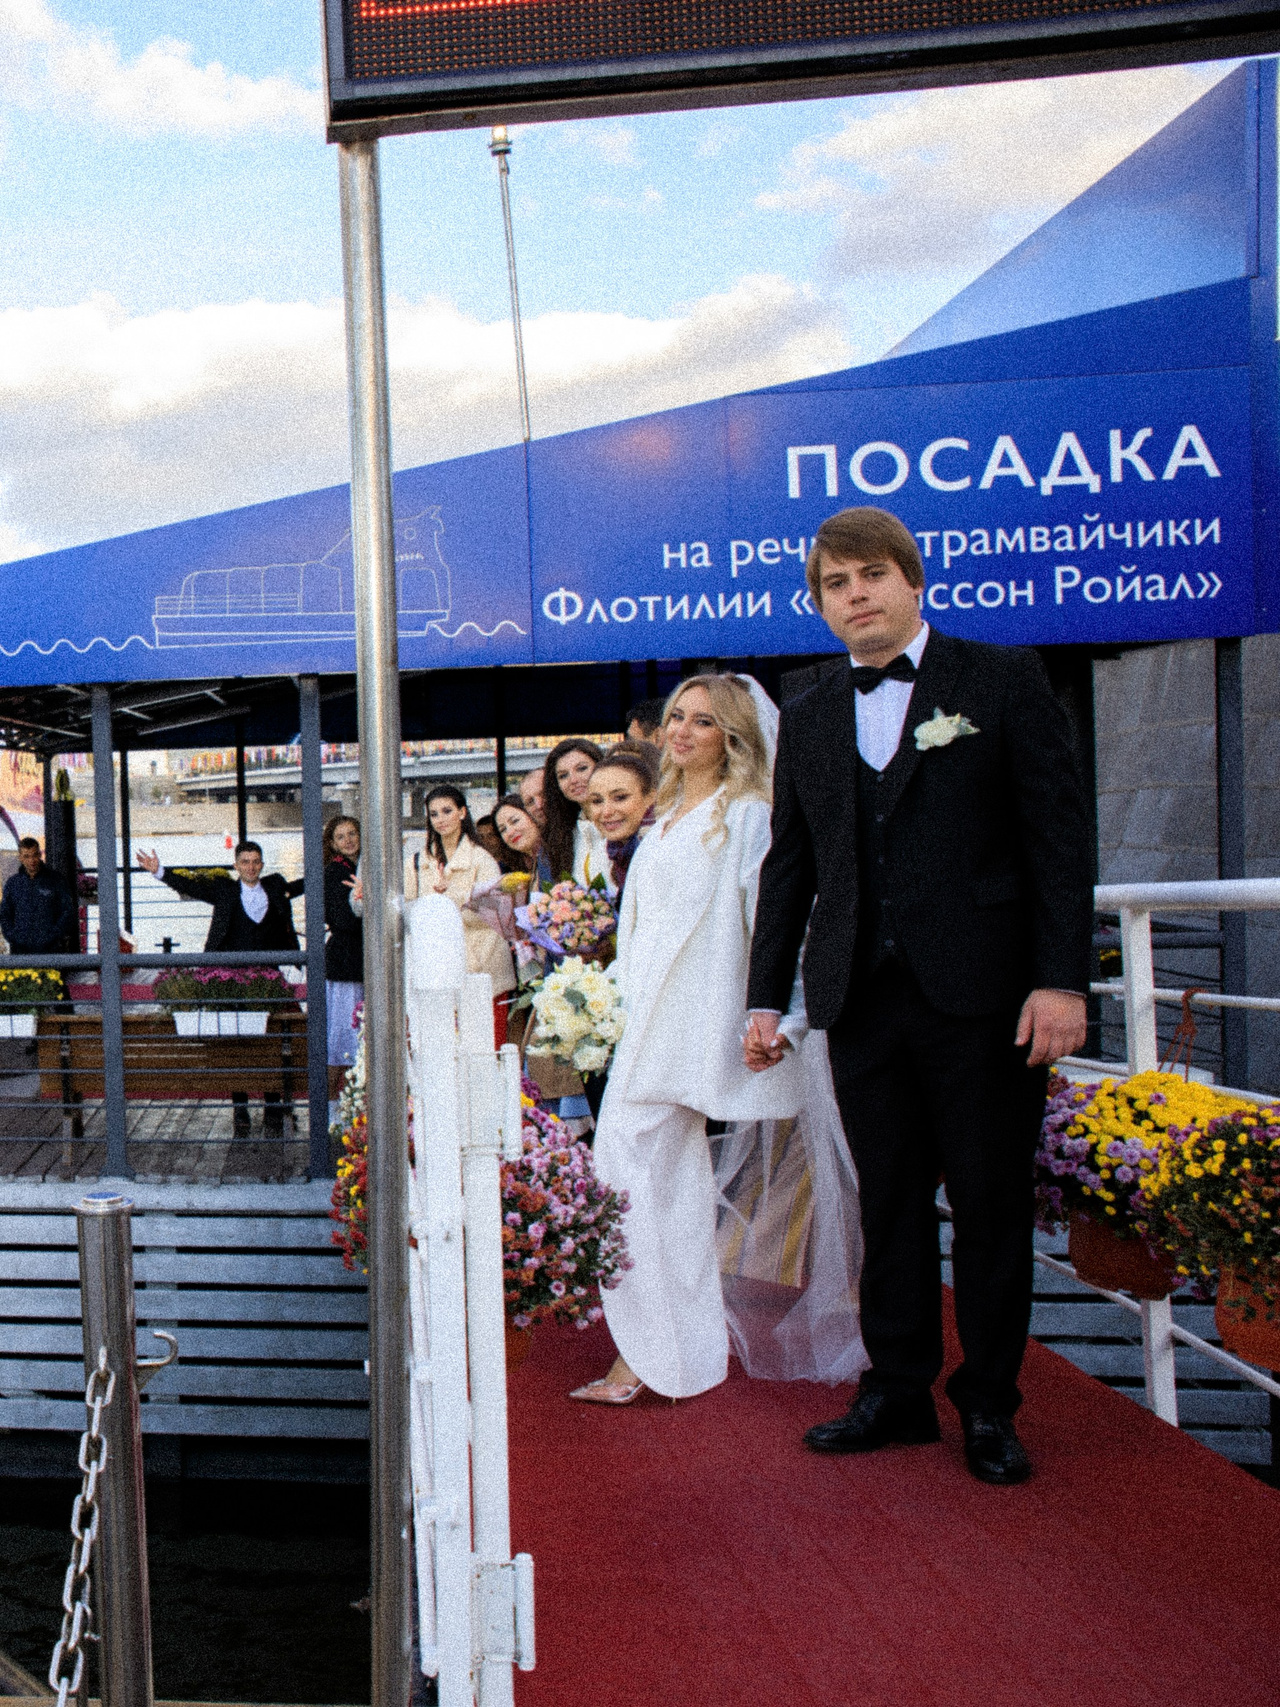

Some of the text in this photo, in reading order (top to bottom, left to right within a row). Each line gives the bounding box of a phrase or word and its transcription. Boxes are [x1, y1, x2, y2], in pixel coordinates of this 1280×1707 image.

[786, 424, 1222, 499] ПОСАДКА
[662, 541, 713, 569] на
[916, 513, 1221, 569] трамвайчики
[542, 587, 772, 626] Флотилии
[1055, 564, 1223, 605] Ройал»
